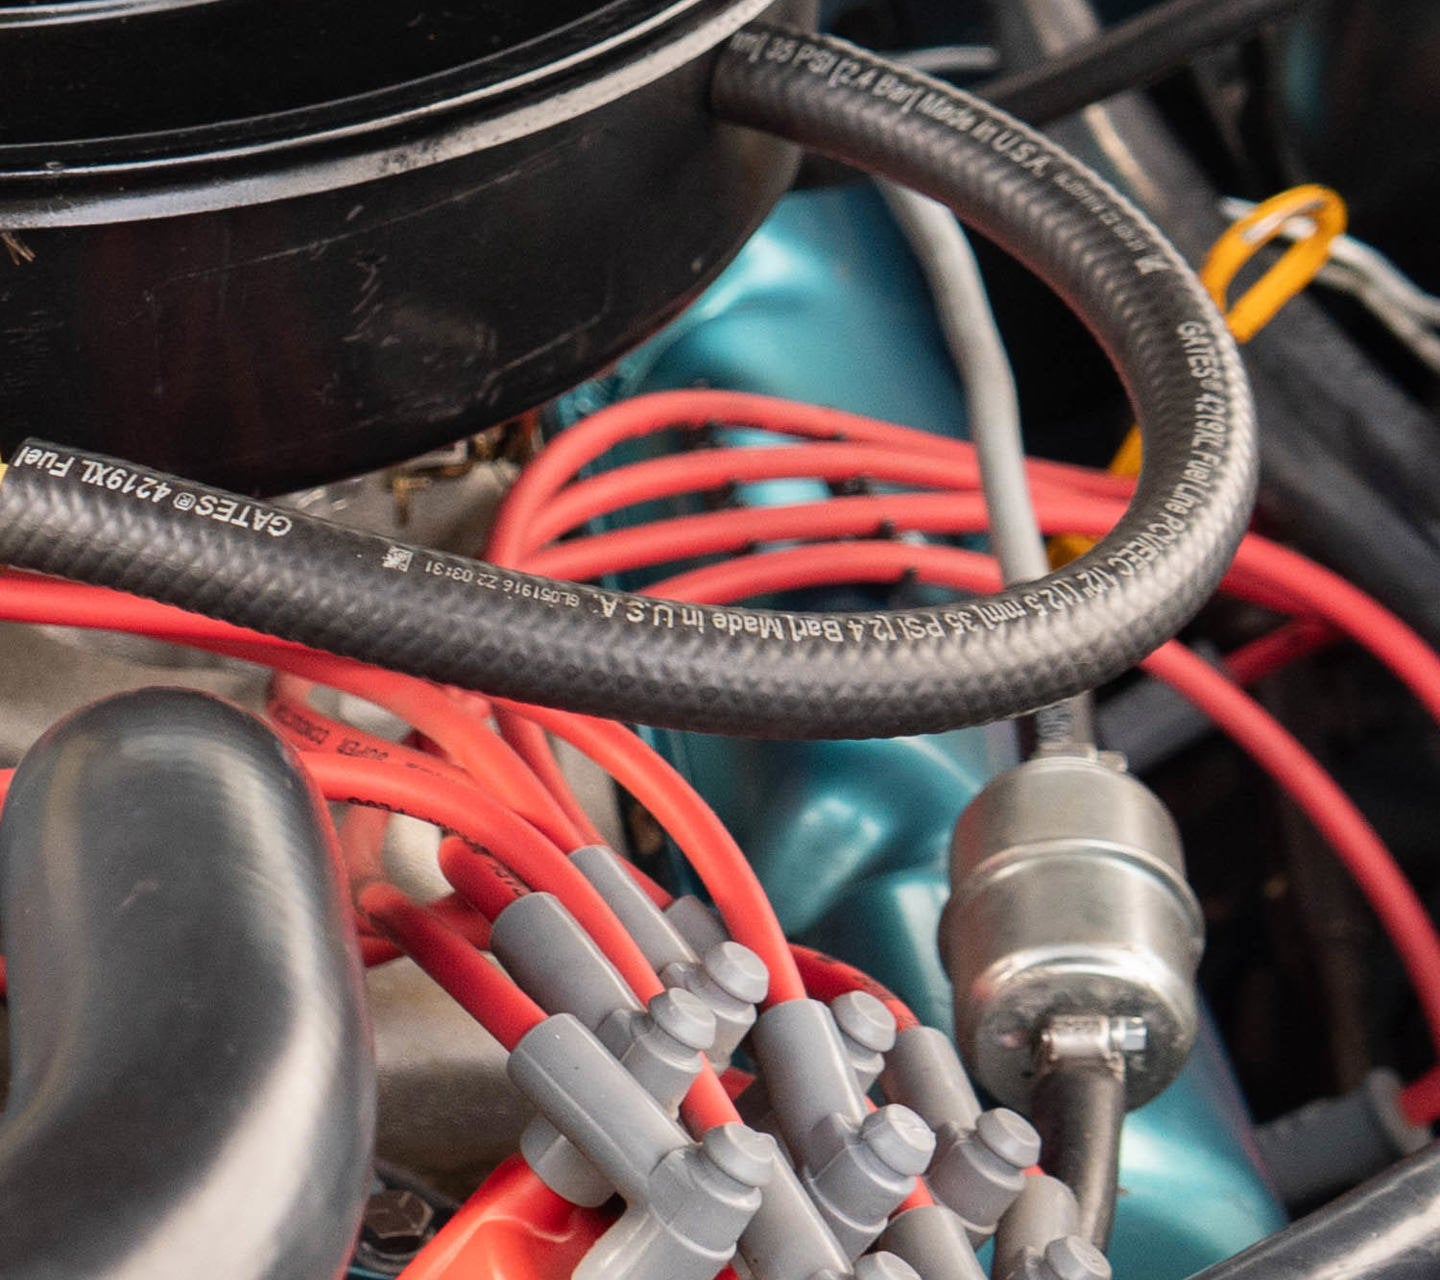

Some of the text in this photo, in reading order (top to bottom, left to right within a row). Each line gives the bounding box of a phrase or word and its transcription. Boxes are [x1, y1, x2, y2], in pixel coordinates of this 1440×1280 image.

[794, 44, 836, 73] PSI
[14, 445, 74, 478] Fuel
[1185, 450, 1220, 486] Fuel
[81, 459, 171, 503] 4219XL
[1165, 480, 1202, 515] Line
[682, 609, 704, 634] in
[713, 612, 784, 641] Made
[902, 614, 946, 640] PSI
[944, 608, 975, 635] 35
